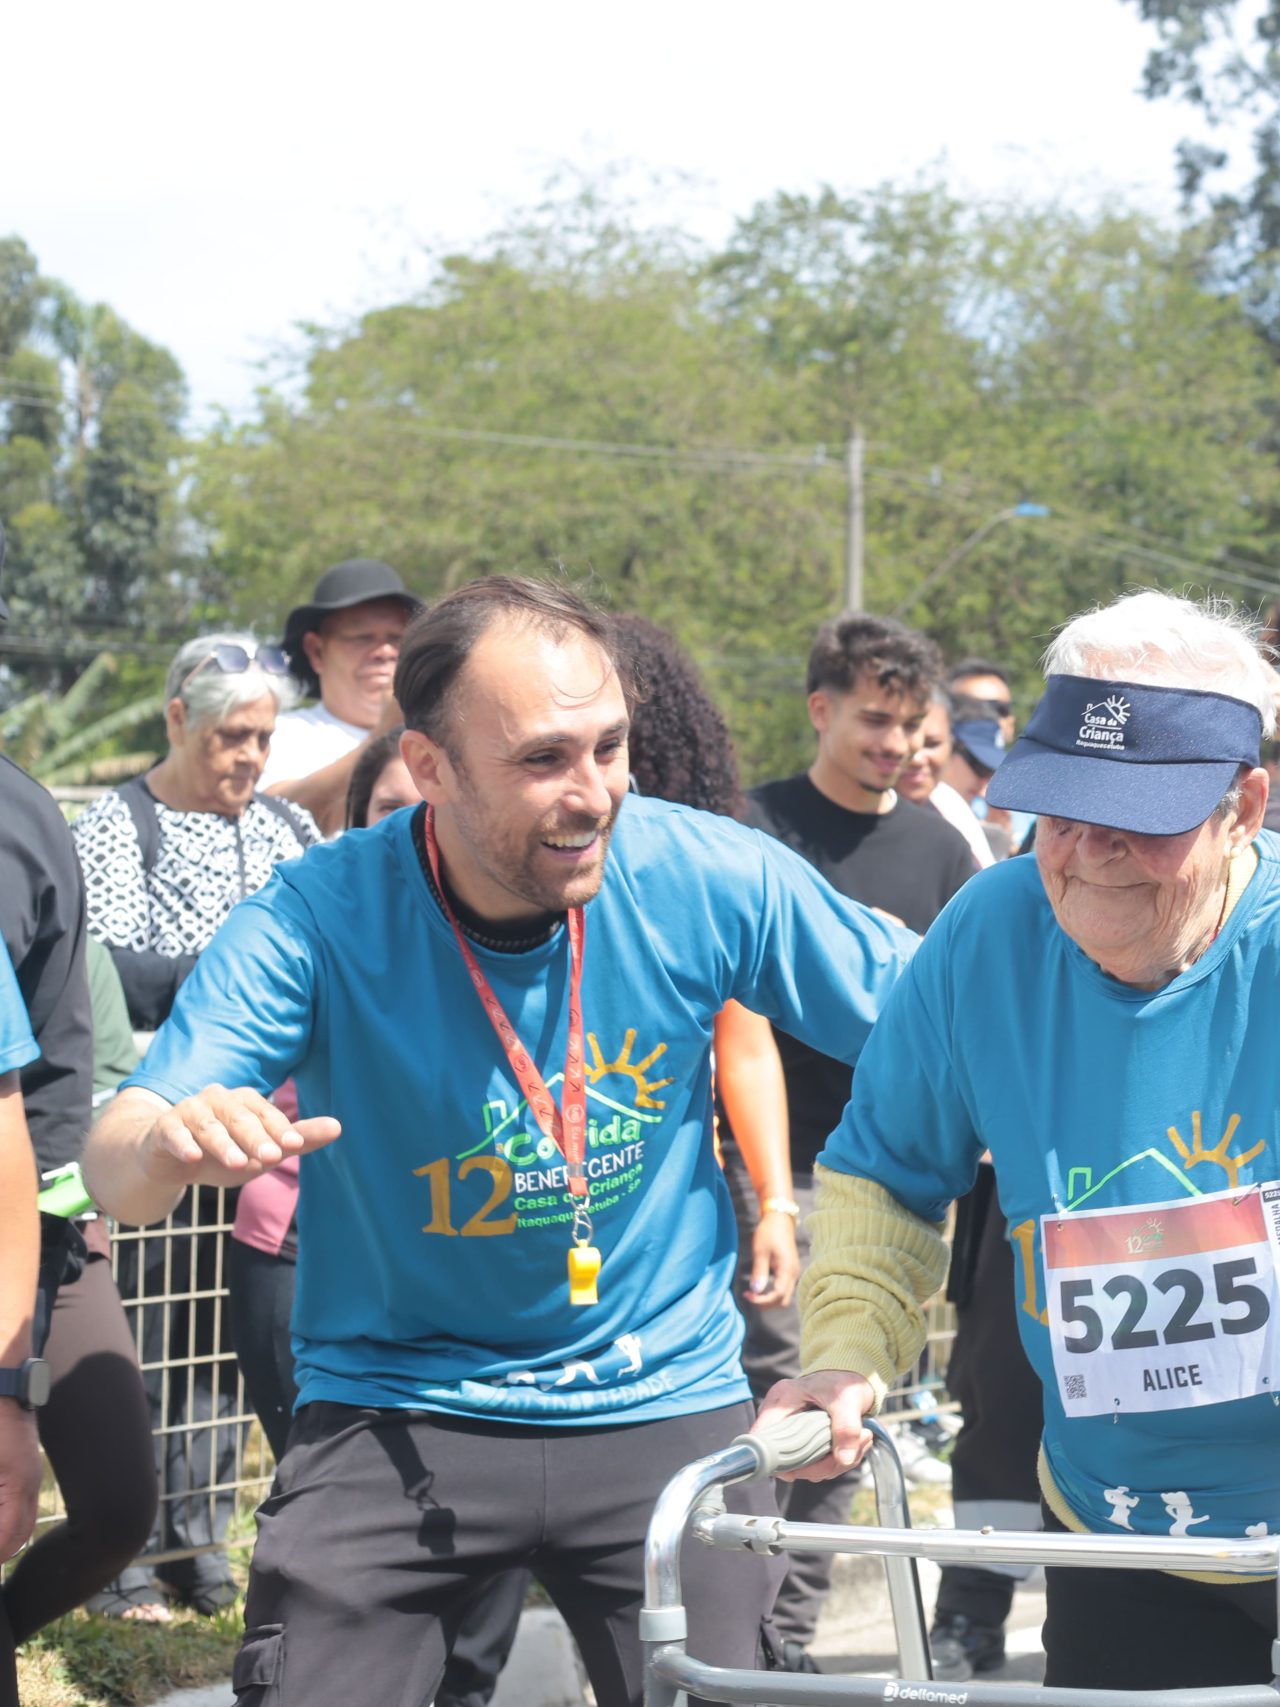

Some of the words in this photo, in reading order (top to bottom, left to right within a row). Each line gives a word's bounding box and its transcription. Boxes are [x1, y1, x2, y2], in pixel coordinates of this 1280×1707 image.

[1084, 713, 1106, 725] Casa
[1107, 718, 1118, 726] da
[1079, 726, 1124, 744] Criança
[504, 1115, 642, 1166] Coida
[514, 1195, 558, 1211] Casa
[589, 1163, 643, 1196] Criança
[628, 1178, 642, 1193] SP
[1060, 1257, 1271, 1354] 5225
[1143, 1364, 1203, 1392] ALICE
